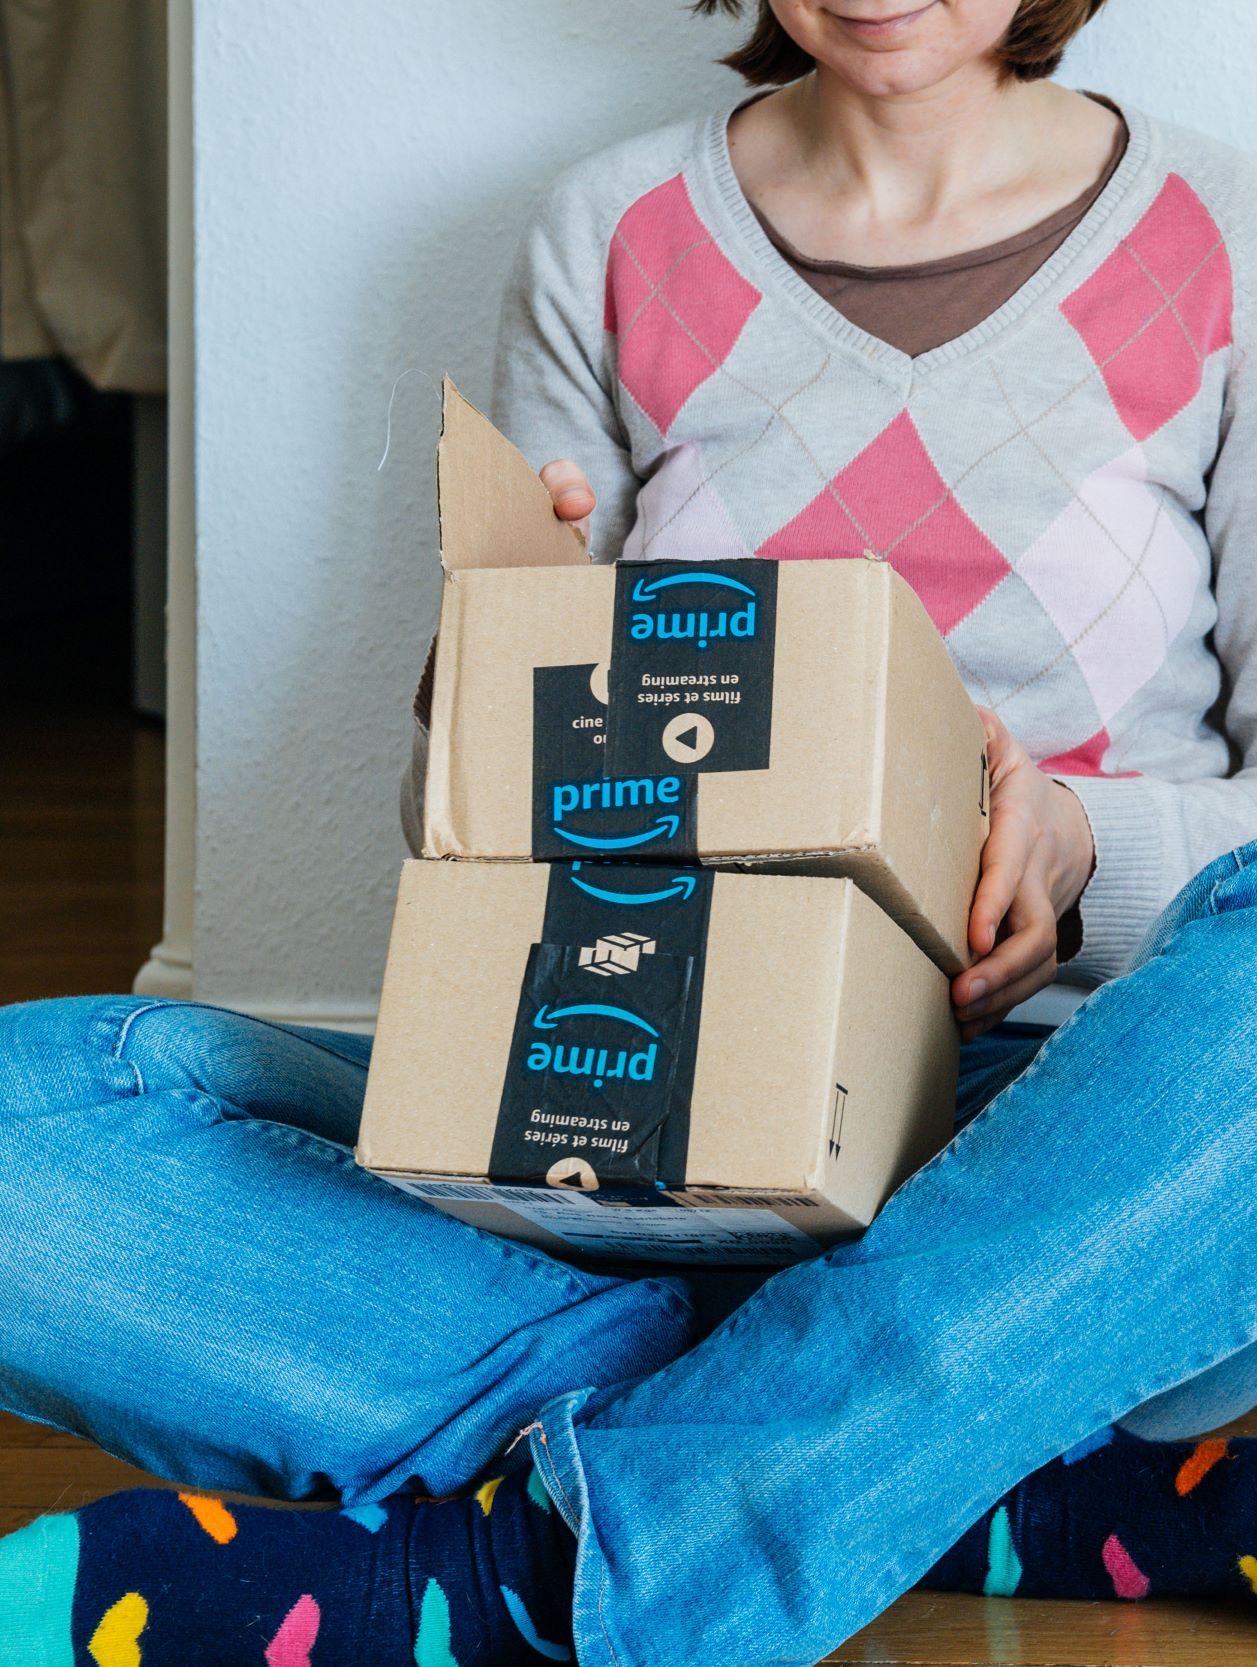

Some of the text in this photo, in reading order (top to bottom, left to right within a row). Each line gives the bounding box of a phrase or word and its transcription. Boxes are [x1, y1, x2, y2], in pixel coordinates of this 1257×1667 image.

[630, 602, 756, 648] prime
[641, 673, 740, 689] en streaming
[637, 691, 741, 706] films et séries
[572, 716, 603, 729] cine
[553, 776, 681, 822] prime
[526, 1042, 658, 1088] prime
[530, 1109, 630, 1132] en streaming
[524, 1130, 629, 1153] films et séries
